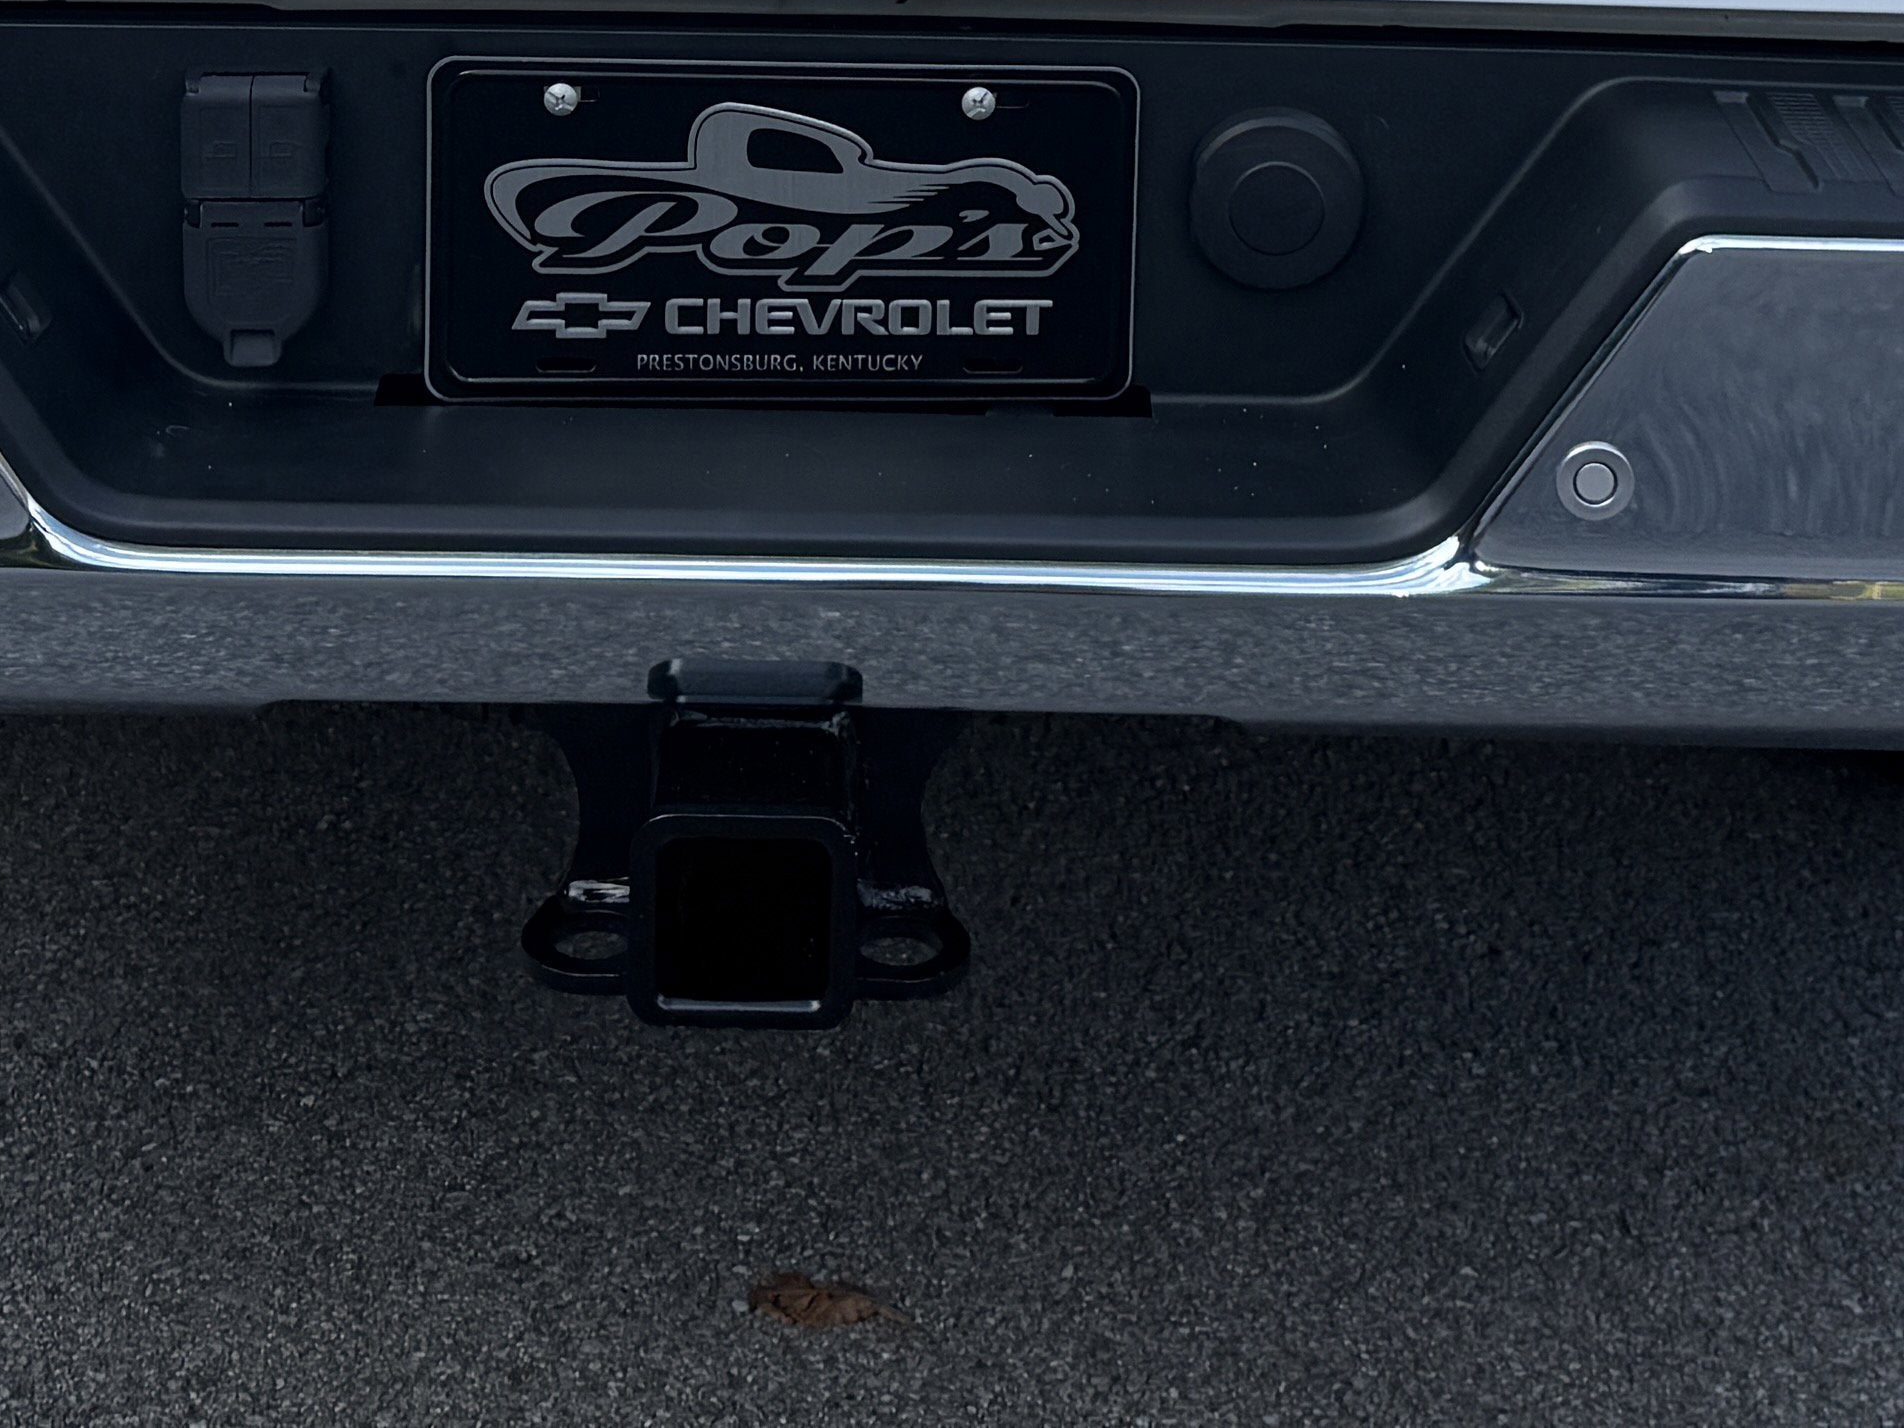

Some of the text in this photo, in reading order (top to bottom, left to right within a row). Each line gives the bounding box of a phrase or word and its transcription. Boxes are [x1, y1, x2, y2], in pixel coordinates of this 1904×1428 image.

[533, 191, 1044, 275] Pop's
[664, 298, 1053, 336] CHEVROLET
[637, 354, 925, 374] PRESTONSBURG, KENTUCKY
